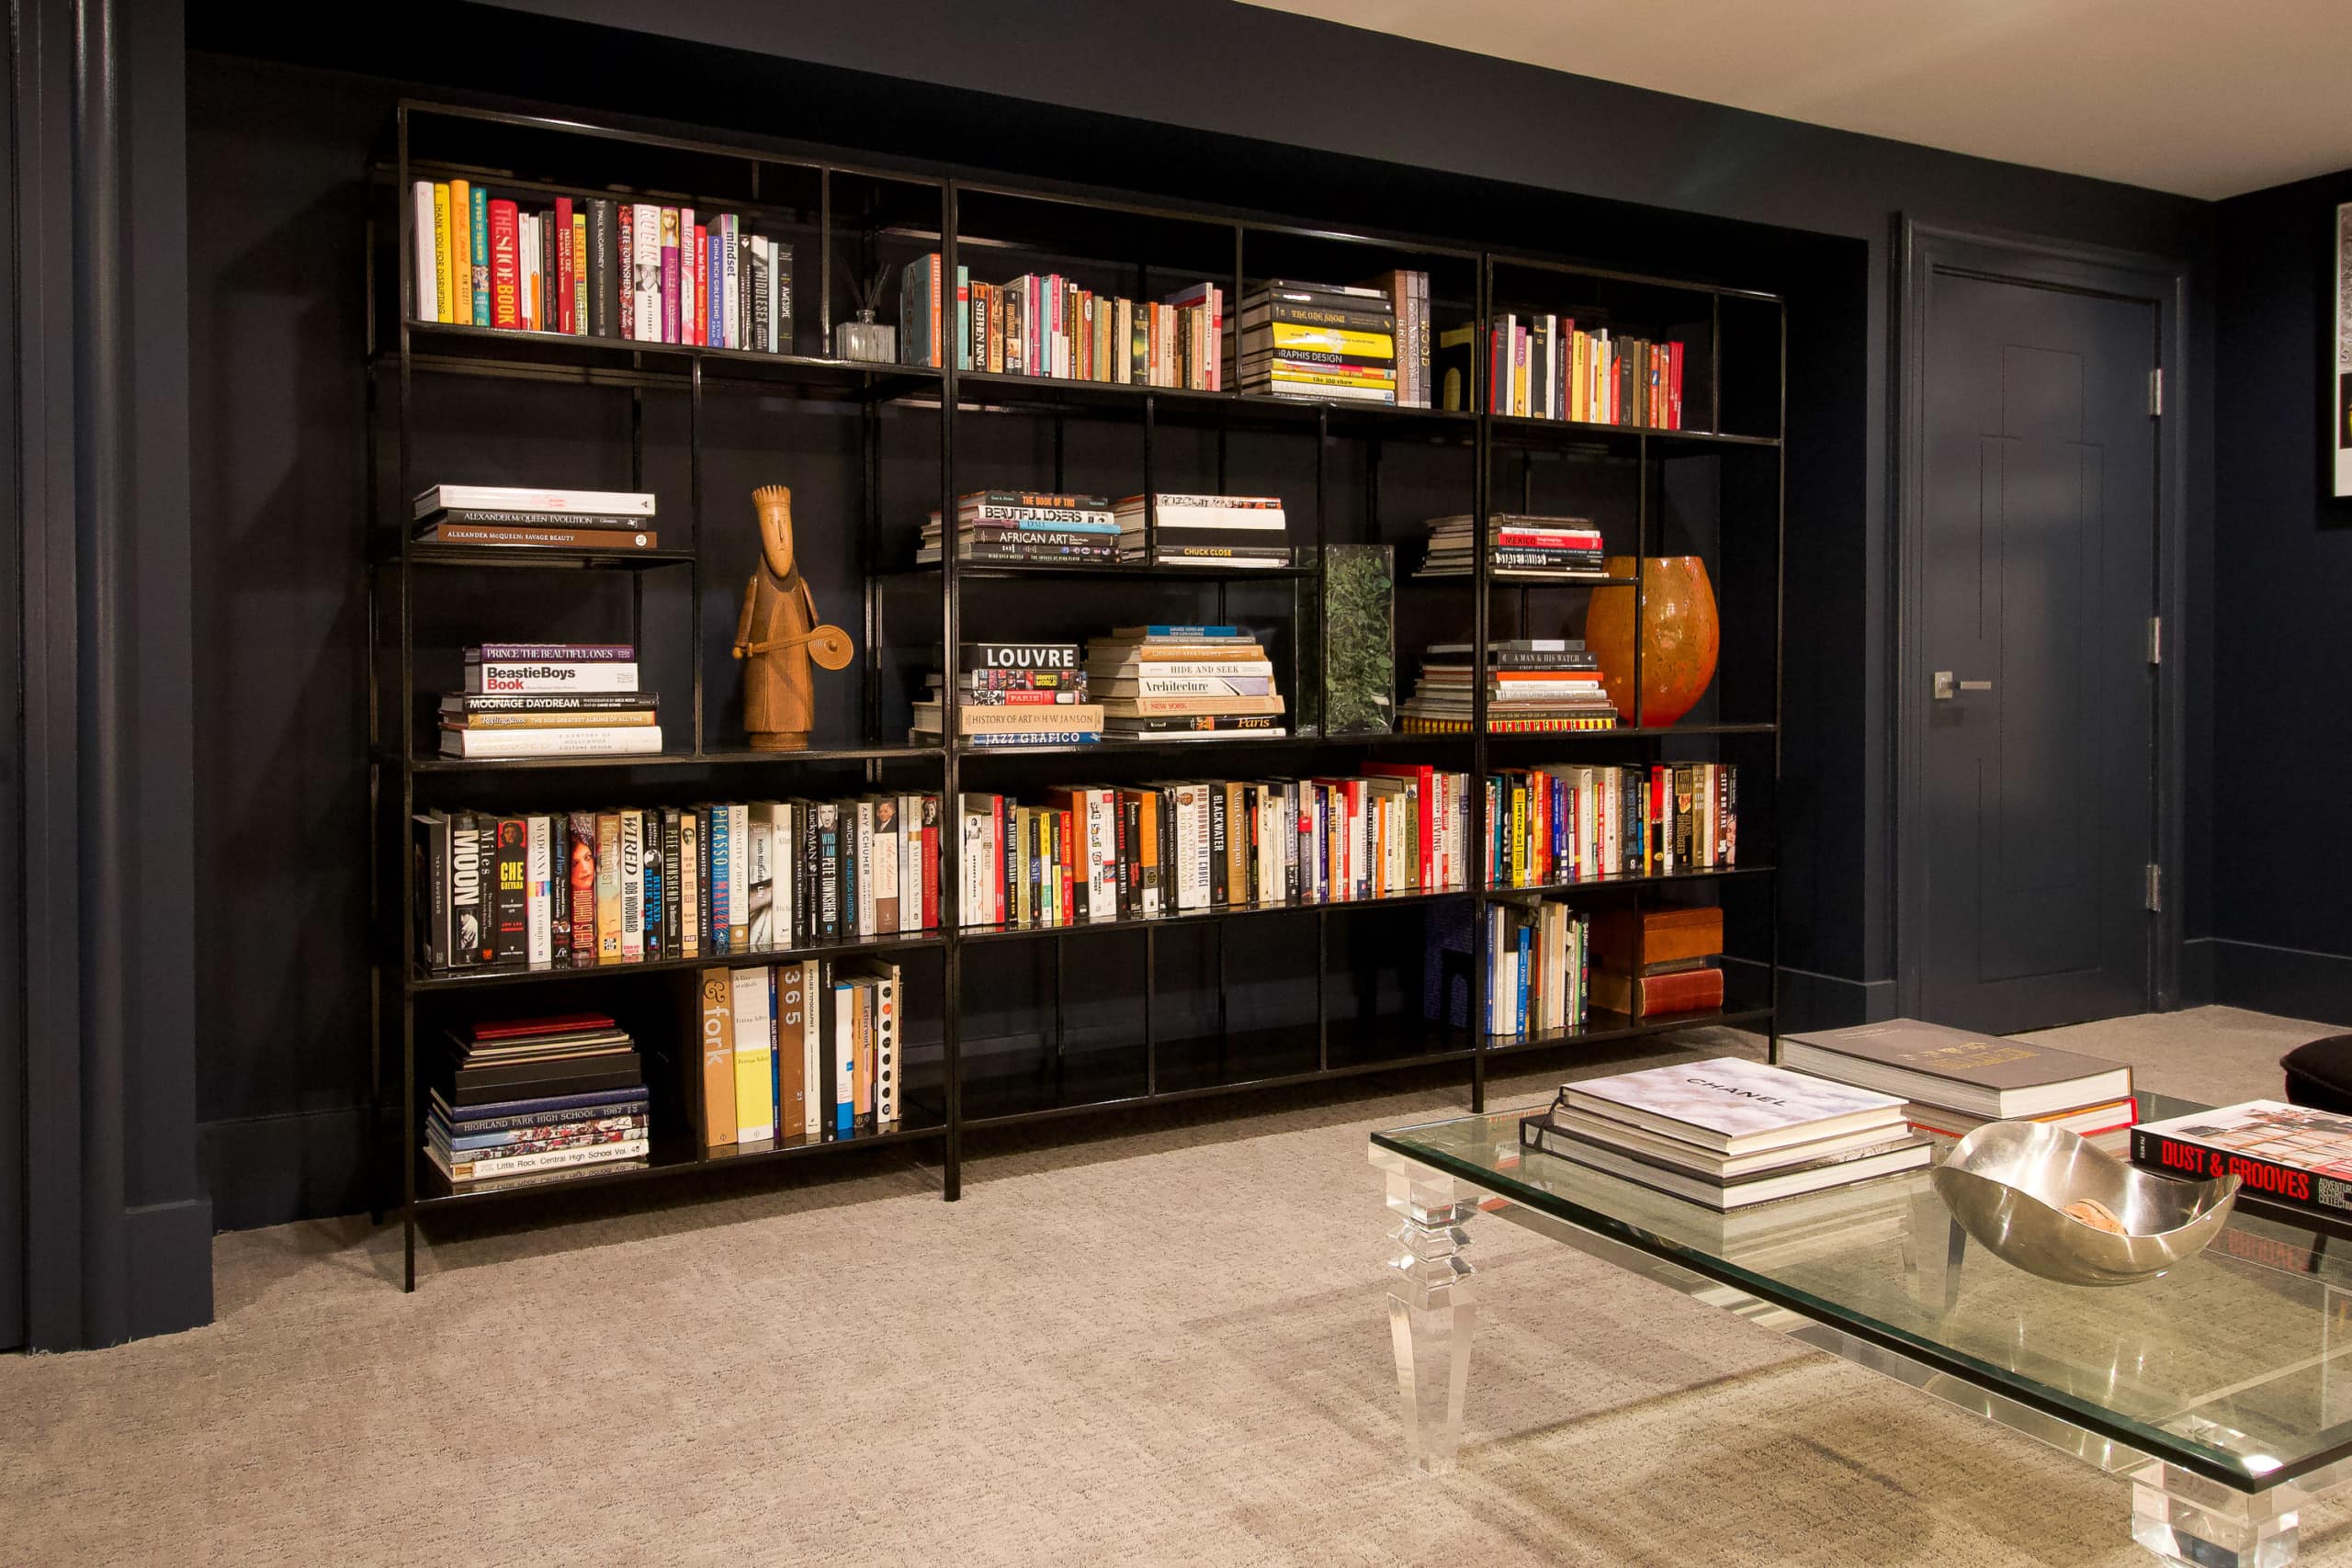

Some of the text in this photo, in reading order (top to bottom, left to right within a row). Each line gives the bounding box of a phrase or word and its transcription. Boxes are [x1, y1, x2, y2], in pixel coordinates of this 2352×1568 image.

[435, 203, 443, 228] THANK
[496, 209, 512, 236] THE
[683, 223, 695, 266] LIZ PHAIR
[726, 231, 737, 277] mindset
[622, 225, 633, 299] PETE TOWNSHEND
[437, 269, 446, 315] DISRUPTING
[497, 285, 515, 325] BOOK
[756, 269, 769, 323] MIDDLESEX
[781, 286, 791, 319] AWESOME
[1308, 311, 1323, 321] ONE
[1324, 314, 1345, 322] SHOW
[975, 300, 985, 366] STEPHEN KING
[1398, 319, 1406, 363] BRICK
[1421, 321, 1430, 367] WOOD
[1312, 351, 1343, 363] DESIGN
[984, 507, 1083, 523] BEAUTIFUL LOSERS
[1023, 496, 1033, 506] THE
[1035, 497, 1052, 507] BOOK
[1053, 498, 1062, 507] OF
[464, 513, 508, 522] ALEXANDER
[549, 515, 593, 524] EVOLUTION
[999, 532, 1046, 544] AFRICAN
[1048, 533, 1068, 544] ART
[1184, 548, 1209, 556] CHUCK
[487, 648, 519, 659] PRINCE
[521, 649, 540, 659] THE
[542, 649, 588, 659] BEAUTIFUL
[590, 649, 613, 659] ONES
[987, 649, 1074, 667] LOUVRE
[1514, 654, 1519, 662] A
[1520, 654, 1535, 662] MAN
[1544, 654, 1555, 662] HIS
[1557, 654, 1579, 662] WATCH
[1171, 666, 1239, 674] HIDE AND SEEK
[487, 678, 524, 690] Book
[1146, 681, 1209, 692] Architecture
[469, 698, 580, 708] MOONAGE DAYDREAM
[972, 716, 1005, 724] HISTORY
[1006, 716, 1017, 724] OF
[1019, 716, 1032, 724] ART
[1060, 716, 1093, 724] JANSON
[1238, 718, 1270, 728] Paris
[986, 734, 1015, 744] JAZZ
[1720, 796, 1727, 807] ON
[1198, 788, 1208, 844] BOB WOODWARD
[1213, 795, 1224, 852] BLACKWATER
[822, 833, 835, 844] WHO
[1232, 814, 1242, 867] Greenspan
[1677, 814, 1685, 854] SHRUGGED
[481, 829, 495, 875] Miles
[536, 823, 545, 876] MADONNA
[825, 845, 836, 856] AM
[847, 845, 853, 855] ME
[1008, 823, 1016, 882] ANTHONY BOURDAIN
[453, 829, 479, 905] MOON
[500, 862, 524, 881] CHE
[623, 816, 638, 933] WIRED BOB WOODWARD
[666, 829, 679, 902] PETE TOWNSHEND
[713, 809, 729, 930] PICASSO MAILER
[1031, 861, 1040, 880] Salt
[1198, 846, 1208, 887] THE CHOICE
[500, 881, 524, 890] GUEVARA
[823, 858, 836, 922] PETE TOWNSHEND
[645, 869, 654, 931] BLUE EYES
[573, 891, 593, 949] HOWARD STERN
[703, 979, 733, 1066] & fork
[1686, 1078, 1786, 1106] CHANEL
[464, 1106, 622, 1132] HIGHLAND PARK HIGH SCHOOL 1987
[497, 1161, 514, 1170] Little
[517, 1159, 535, 1168] Rock
[540, 1155, 566, 1165] Central
[569, 1151, 585, 1163] High
[588, 1149, 612, 1159] School
[2161, 1139, 2309, 1201] DUST & GROOVES
[2318, 1187, 2344, 1200] RECORD
